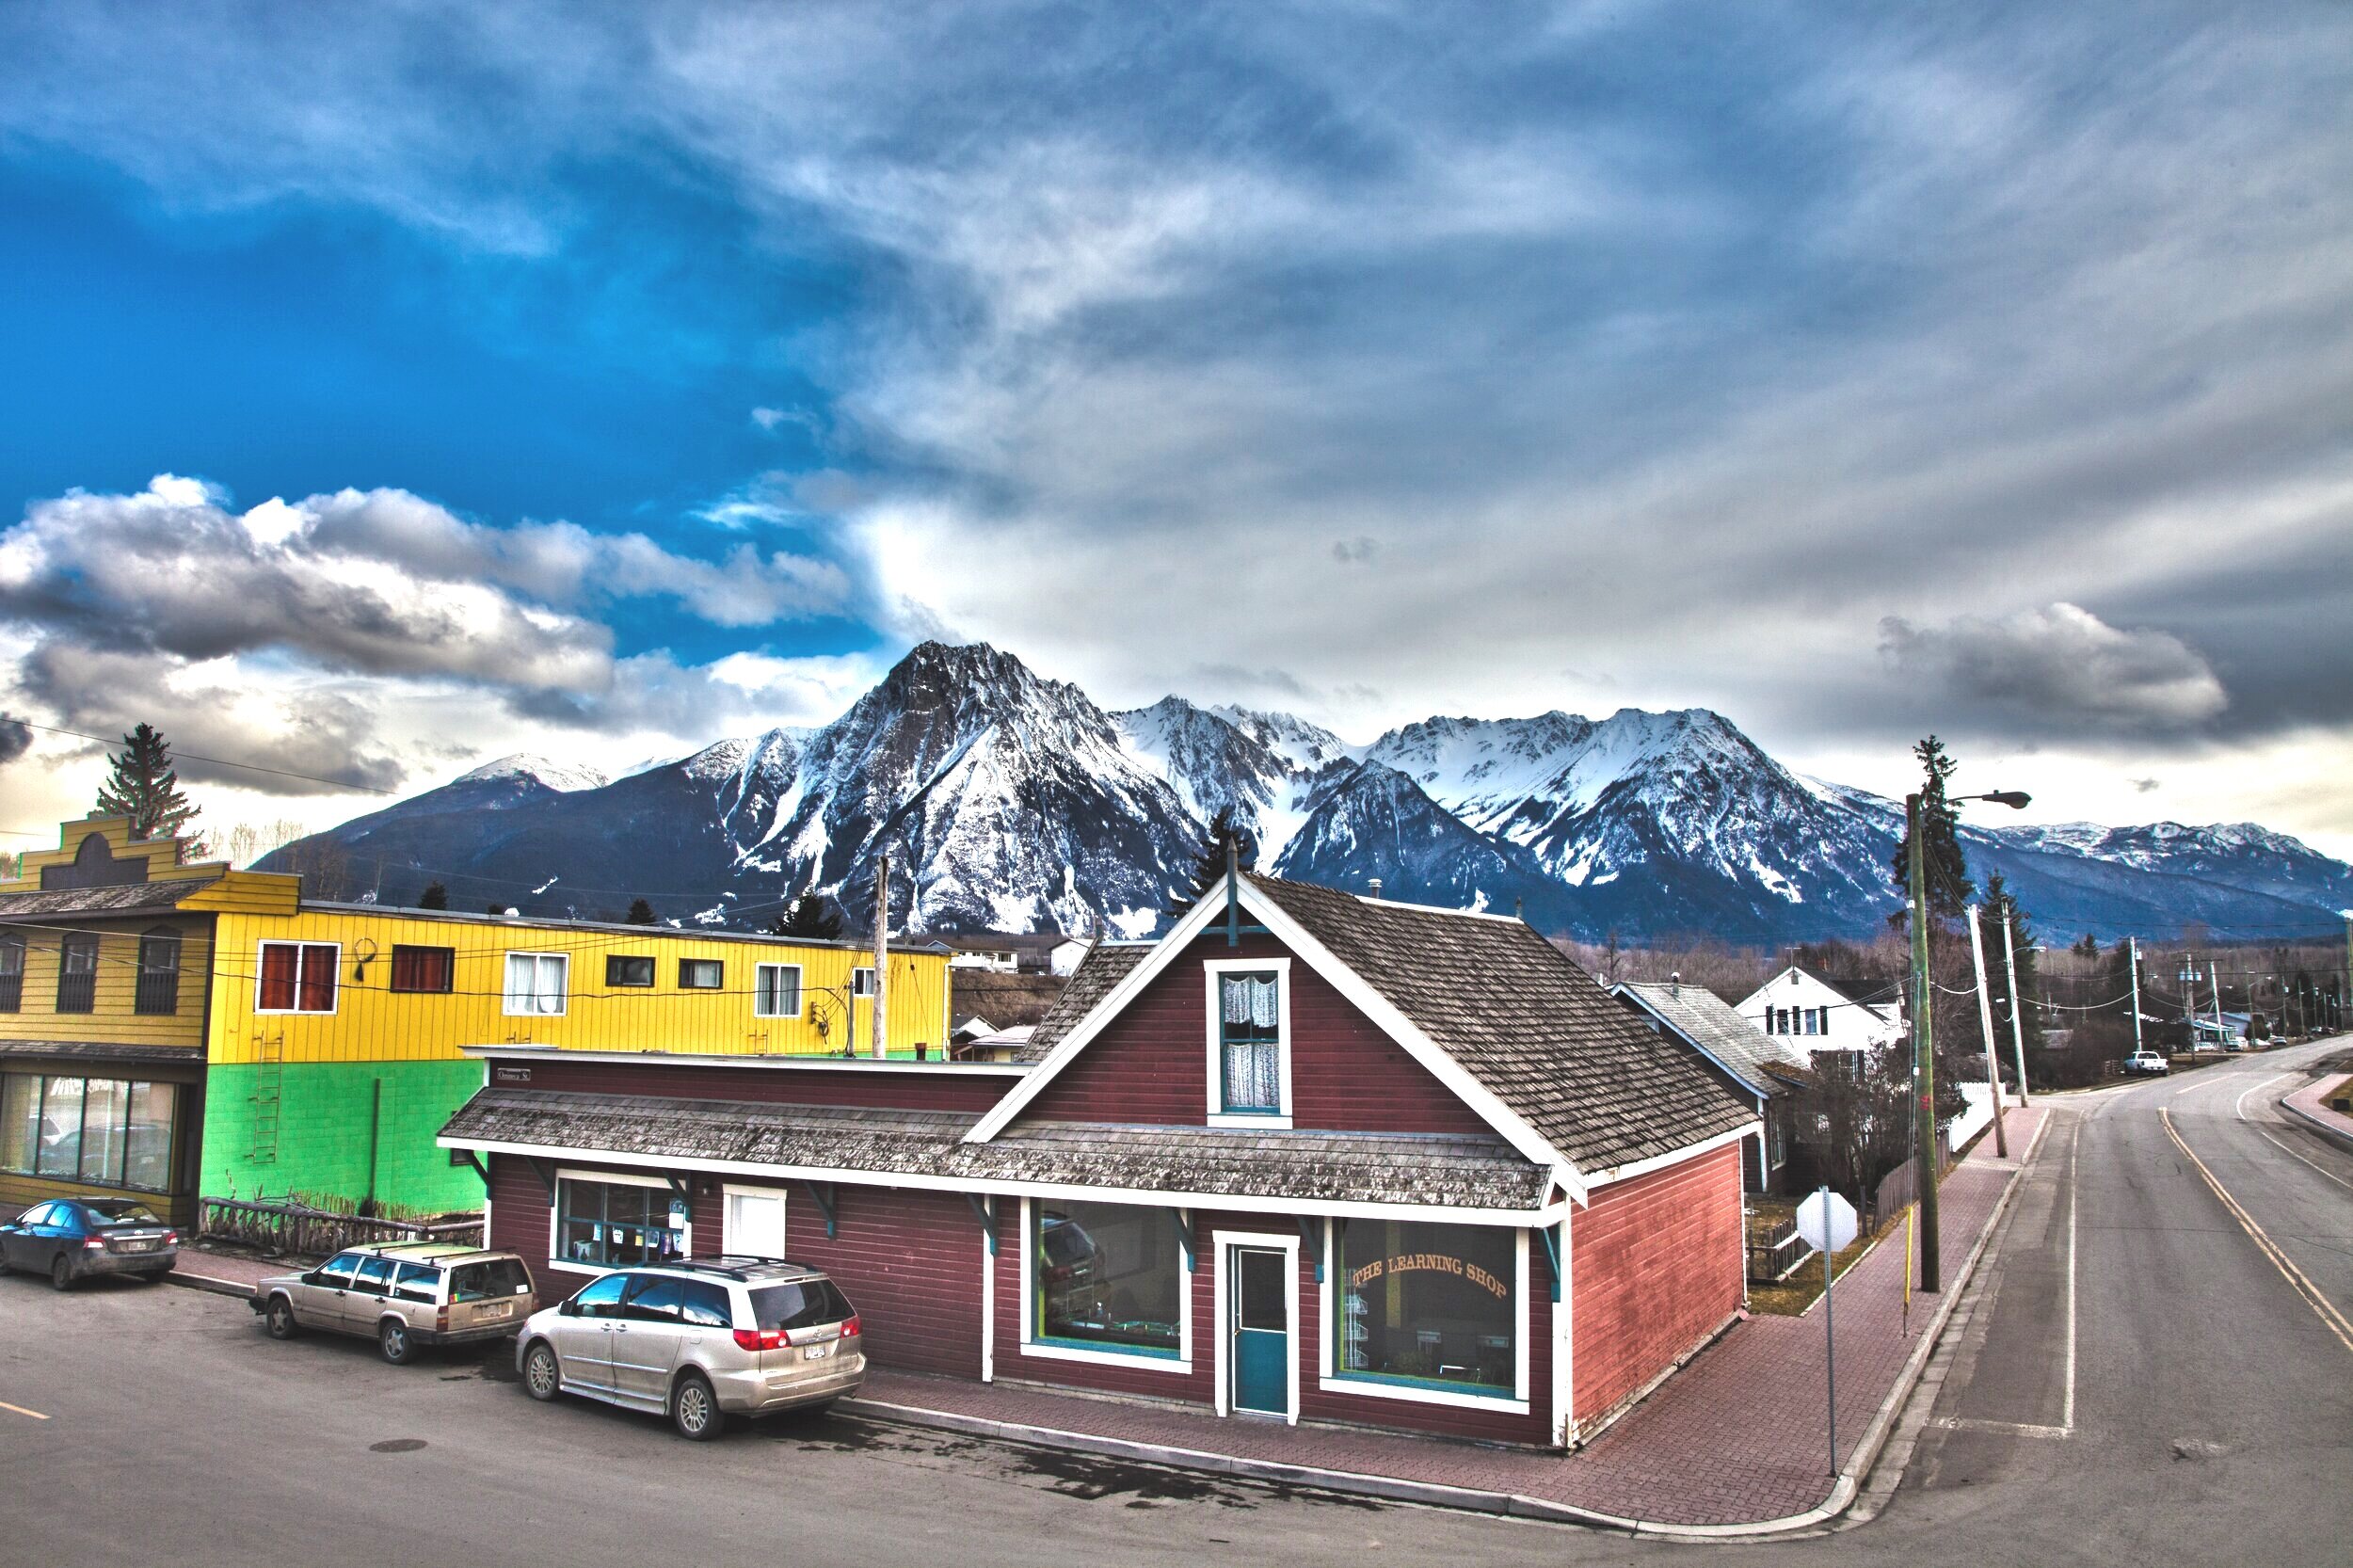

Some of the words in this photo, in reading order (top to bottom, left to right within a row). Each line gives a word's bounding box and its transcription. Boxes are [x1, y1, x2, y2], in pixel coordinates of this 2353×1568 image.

[1353, 1260, 1383, 1288] THE
[1388, 1254, 1463, 1275] LEARNING
[1466, 1262, 1507, 1299] SHOP
